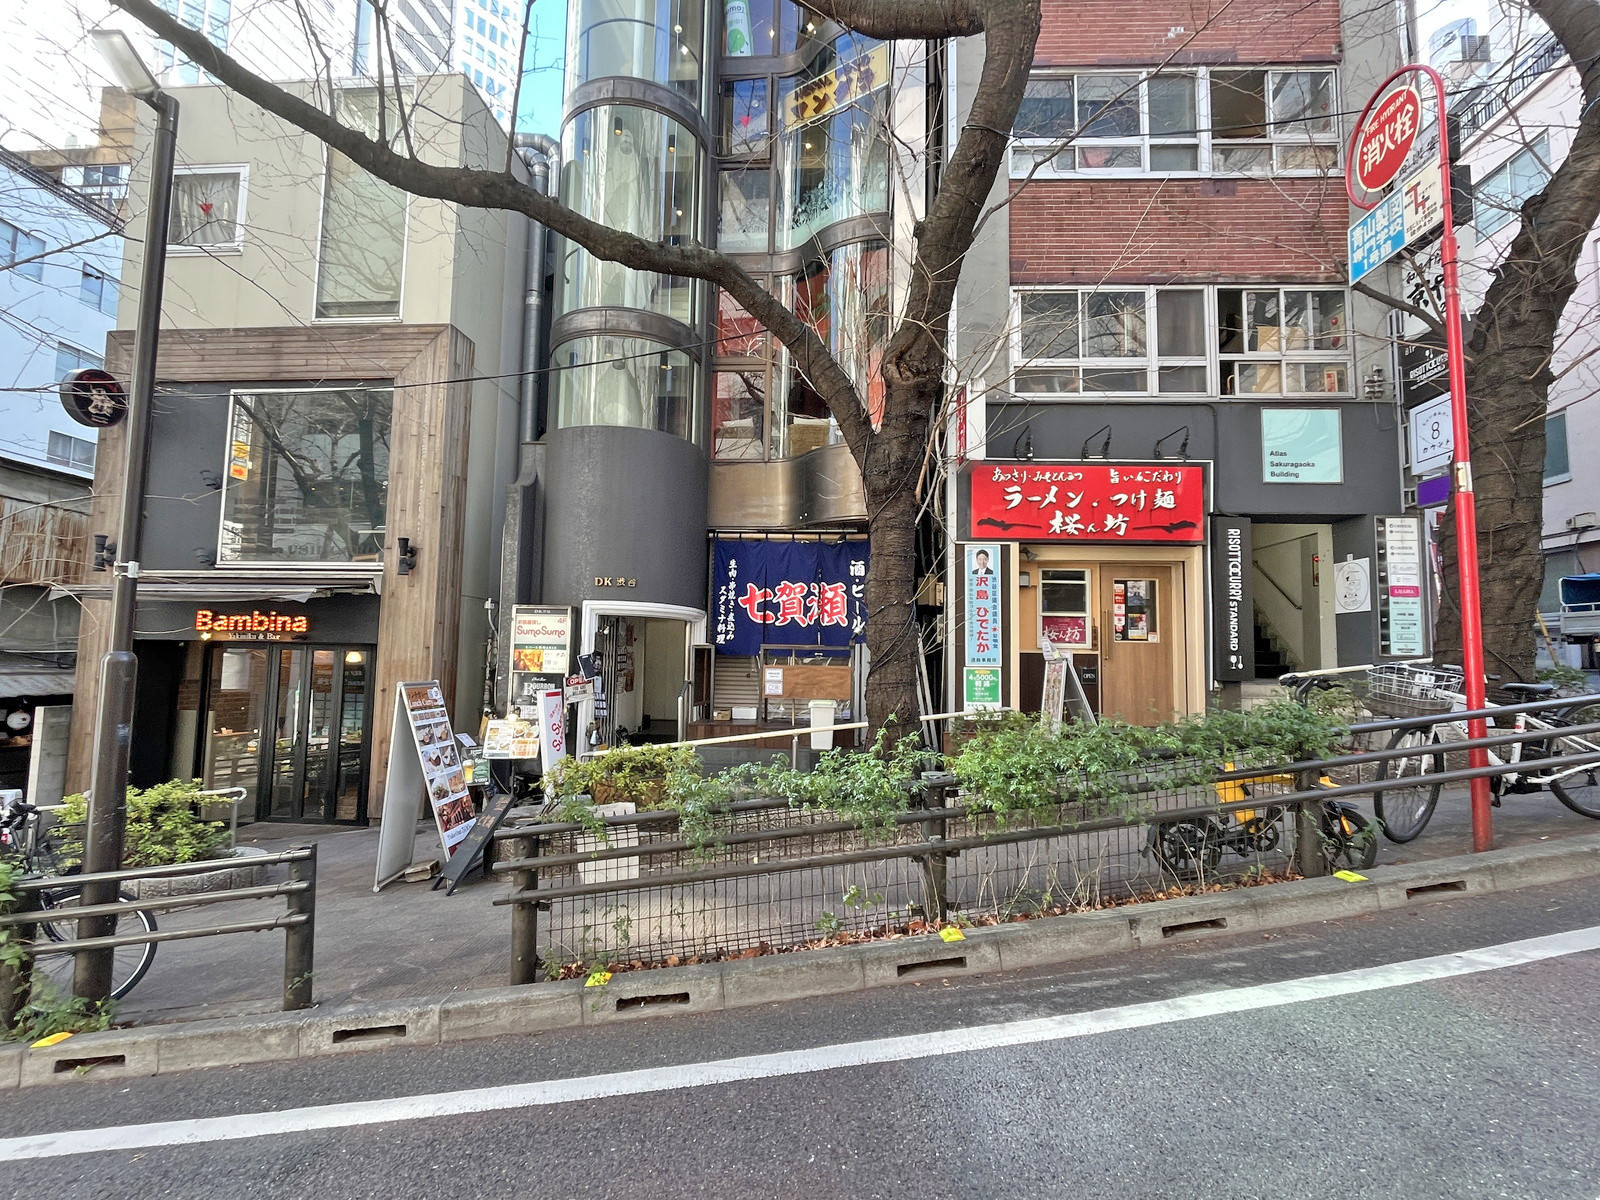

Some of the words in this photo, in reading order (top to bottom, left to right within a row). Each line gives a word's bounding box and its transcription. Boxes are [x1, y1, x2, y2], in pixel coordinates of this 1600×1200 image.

[1366, 122, 1379, 138] FIRE
[1380, 91, 1408, 123] HYDRANT
[1362, 103, 1415, 177] 消火栓
[1352, 193, 1402, 251] 青山製図
[1352, 217, 1403, 263] 専門学校
[1363, 240, 1392, 270] 1号館
[1431, 421, 1440, 440] 8
[1270, 461, 1315, 469] Sakuragaoka
[1270, 471, 1300, 479] Building
[1048, 509, 1130, 536] 桜ん坊
[594, 577, 612, 586] DK
[616, 577, 637, 588] 渋谷
[976, 576, 989, 601] 沢島
[715, 585, 727, 645] スタミナ料理
[738, 580, 849, 628] 七賀瀬
[195, 610, 308, 633] Bambina
[266, 632, 281, 640] Bar
[976, 606, 990, 653] ひでたか
[1229, 600, 1240, 651] STANDARD
